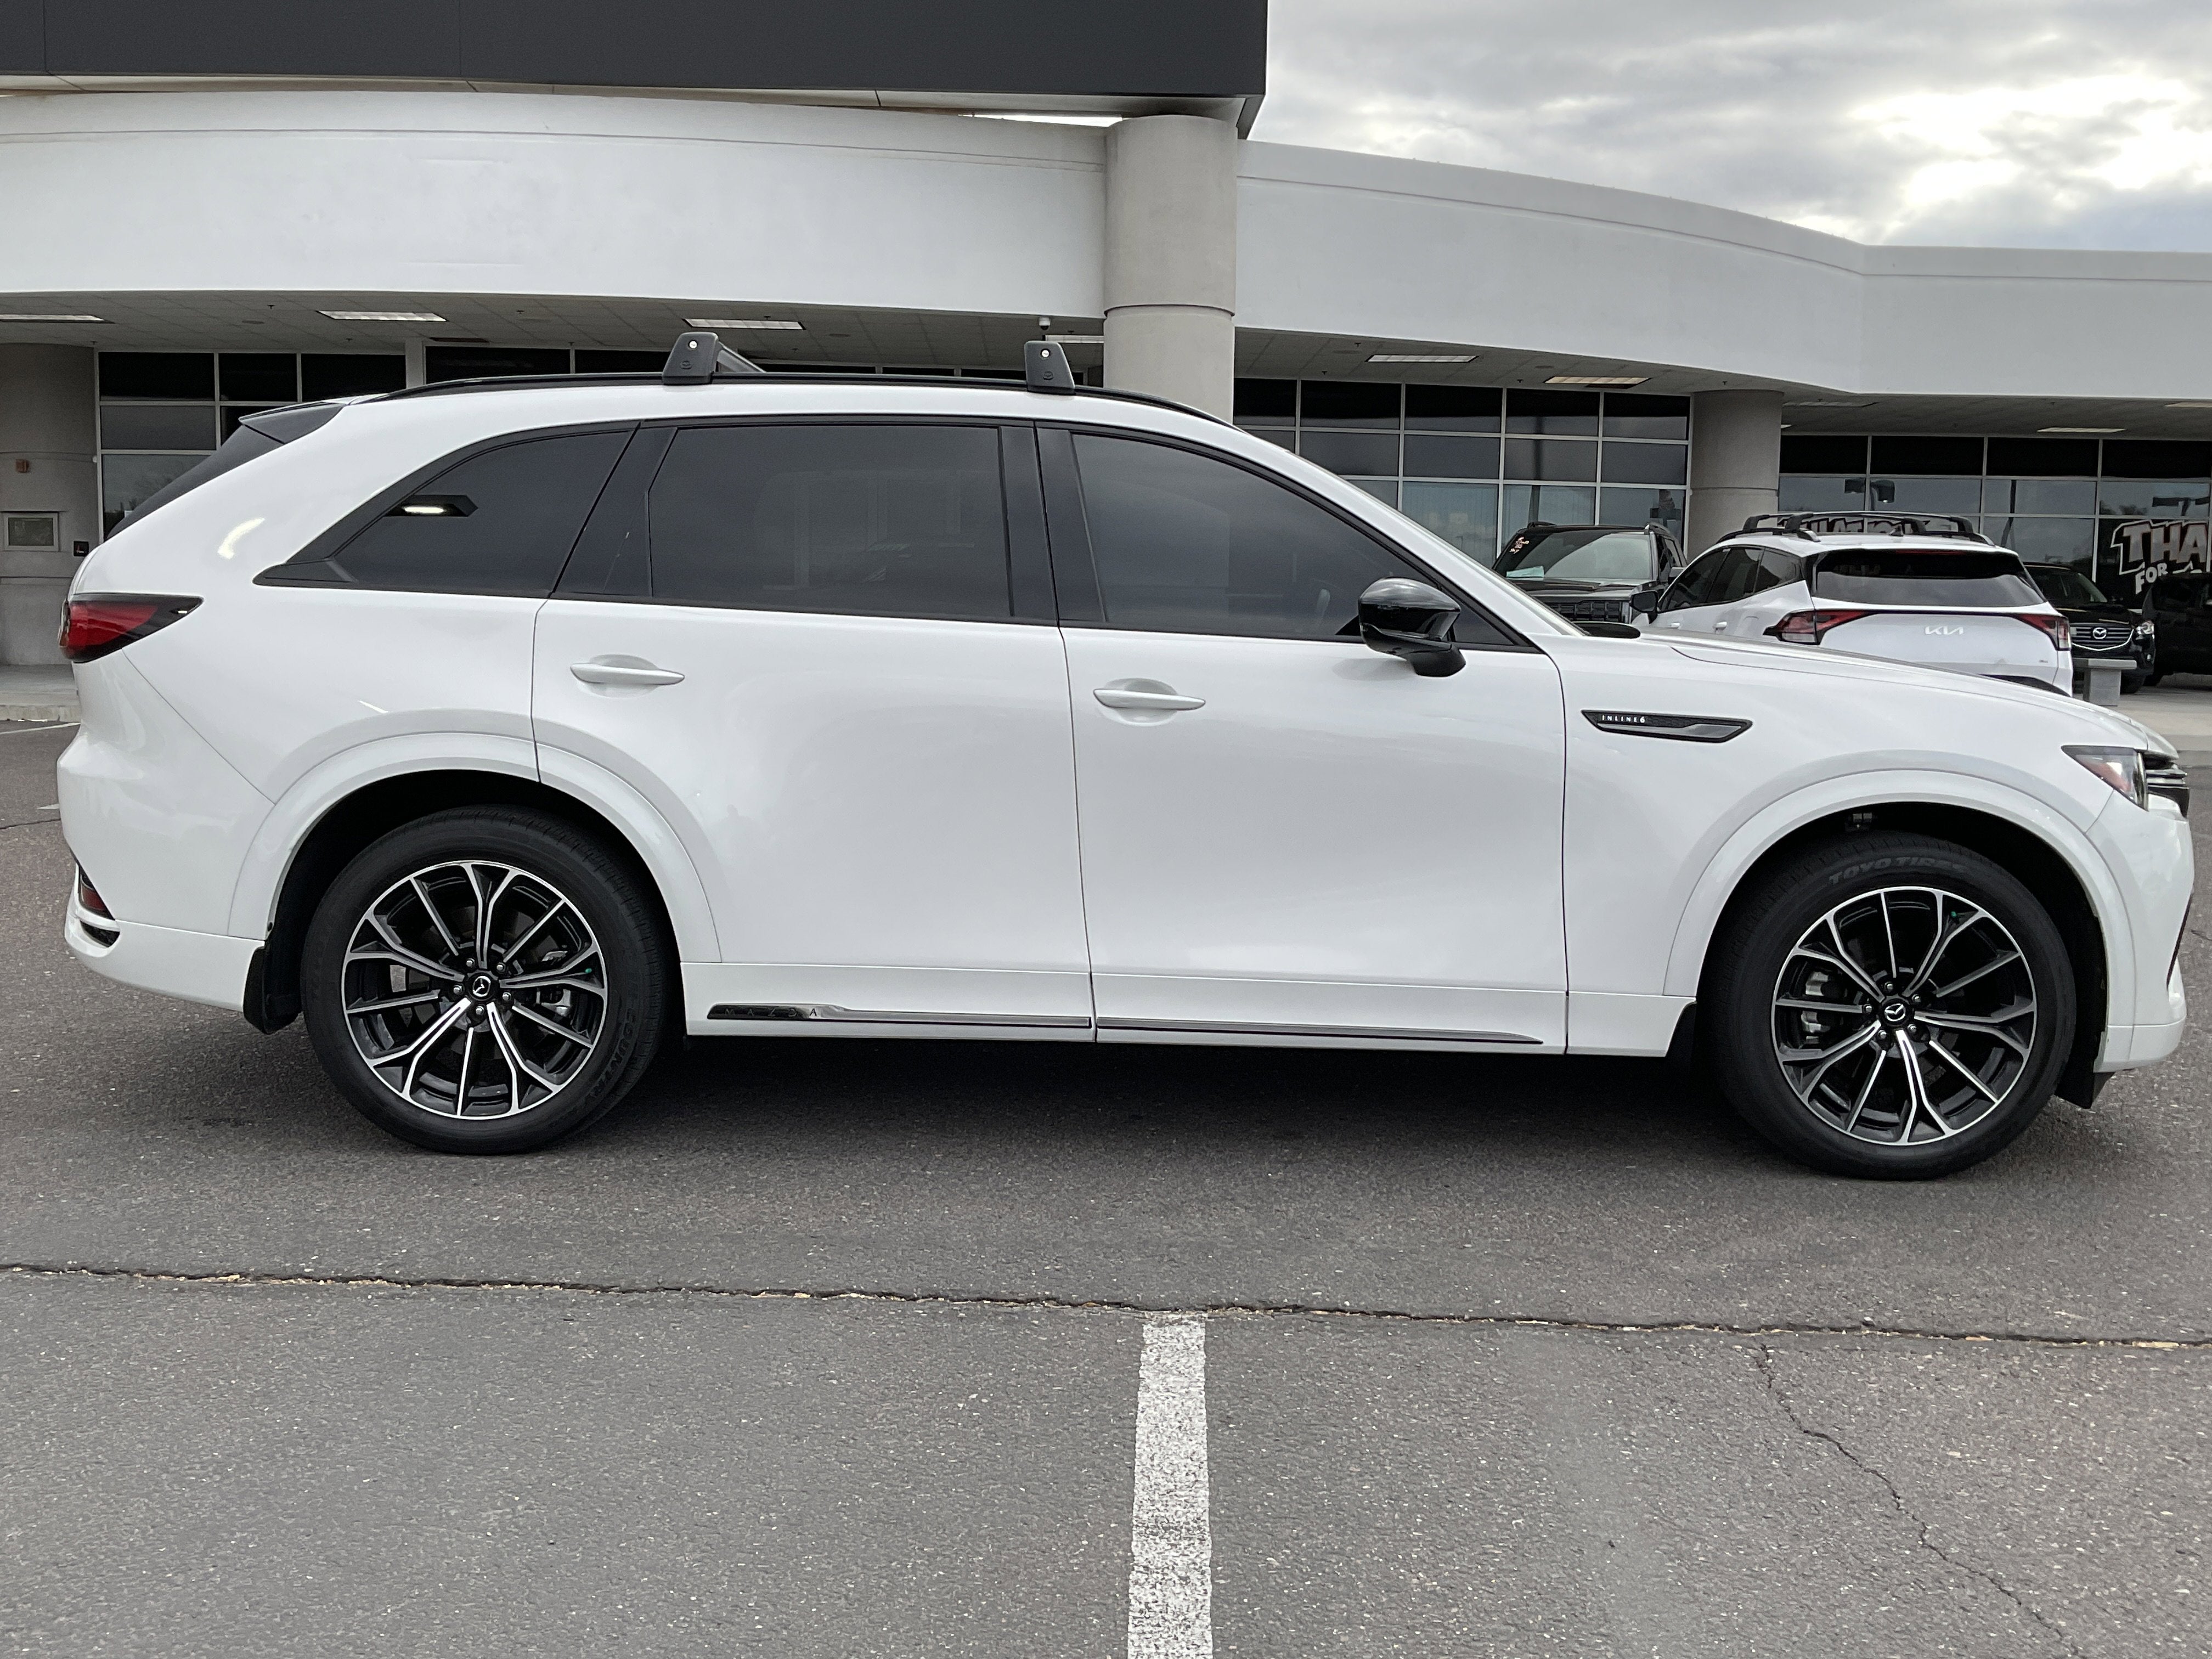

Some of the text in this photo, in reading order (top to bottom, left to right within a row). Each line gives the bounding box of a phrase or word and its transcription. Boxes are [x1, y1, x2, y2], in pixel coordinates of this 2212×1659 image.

[2123, 523, 2212, 563] THA
[2135, 563, 2168, 594] FOR
[1829, 857, 1892, 885] TOYO
[724, 1008, 818, 1017] MAZDA
